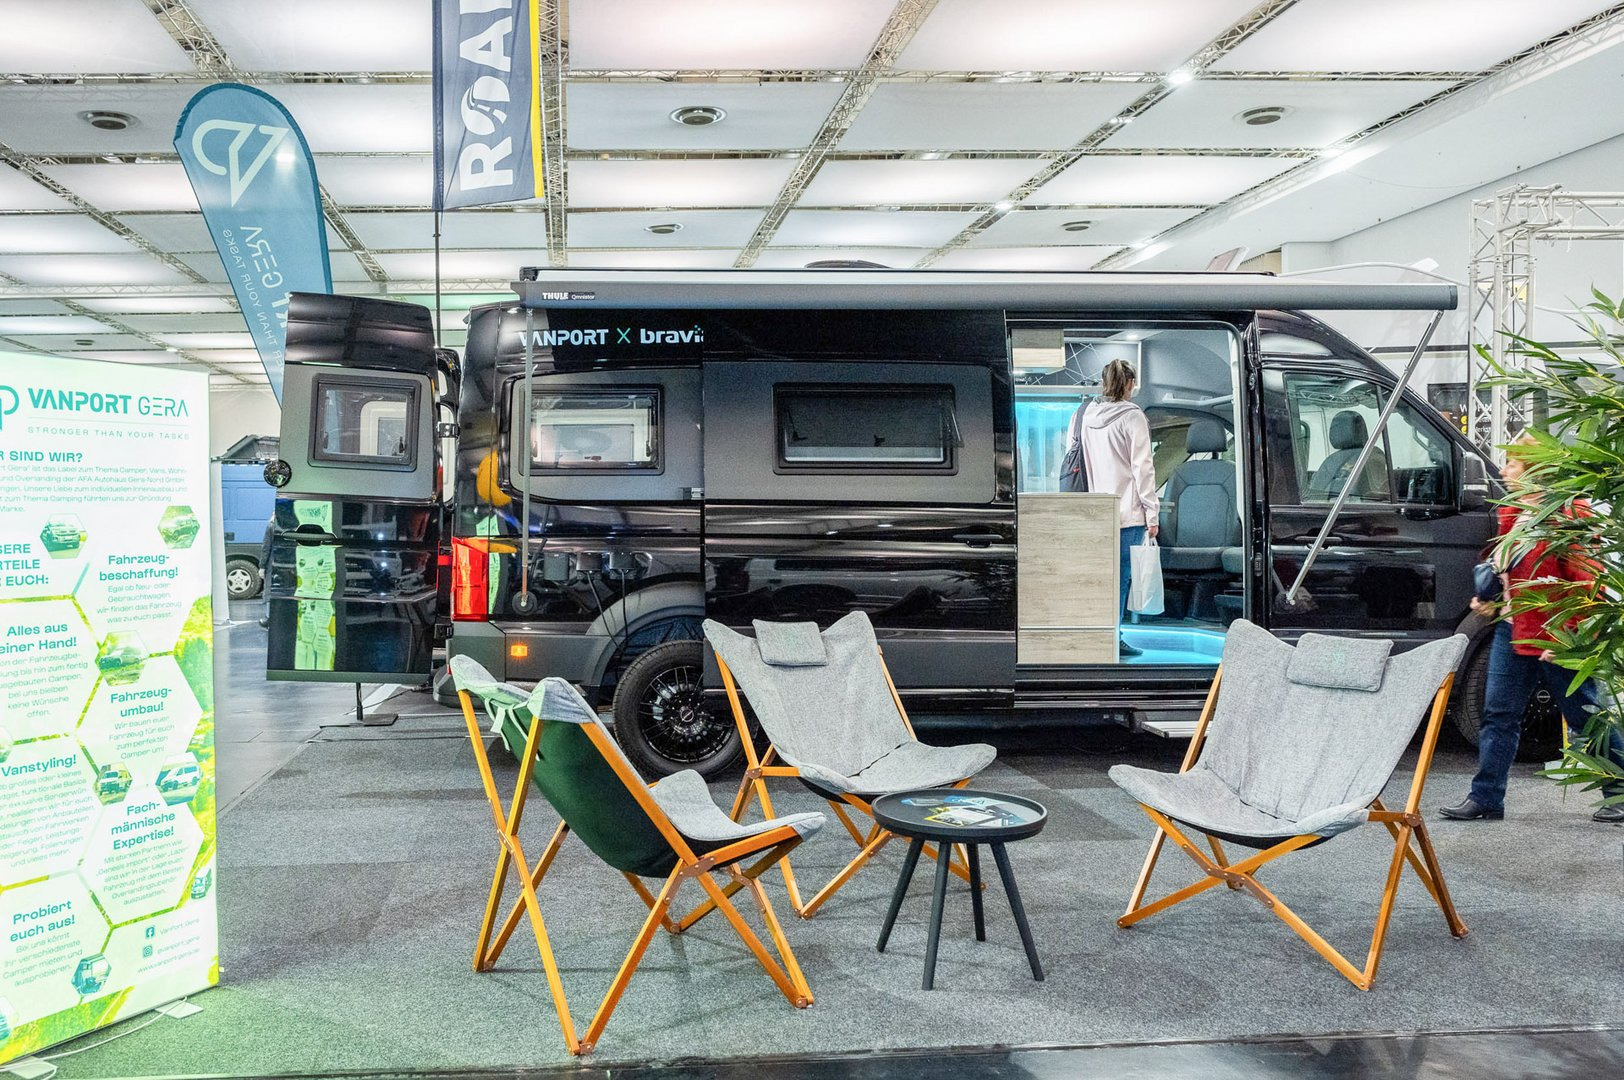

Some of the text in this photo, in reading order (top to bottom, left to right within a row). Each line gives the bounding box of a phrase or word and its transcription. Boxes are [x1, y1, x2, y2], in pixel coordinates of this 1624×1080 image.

[542, 292, 569, 300] THULE
[519, 329, 609, 347] VANPORT
[640, 326, 704, 344] bravi
[28, 388, 189, 417] VANPORT GERA
[28, 426, 190, 440] STRONGER THAN YOUR TASKS
[9, 450, 44, 461] SIND
[49, 452, 83, 462] WIR?
[108, 555, 170, 565] Fahrzeug-
[6, 574, 49, 586] EUCH:
[100, 567, 178, 581] beschaffung!
[6, 624, 68, 637] Alles aus
[39, 637, 77, 650] Hand!
[111, 688, 172, 703] Fahrzeug-
[120, 702, 164, 717] umbau!
[1, 754, 77, 777] Vanstyling!
[127, 801, 160, 816] Fach-
[111, 812, 176, 835] männische
[113, 826, 174, 850] Expertise!
[13, 901, 72, 925] Probiert
[10, 914, 75, 942] euch aus!
